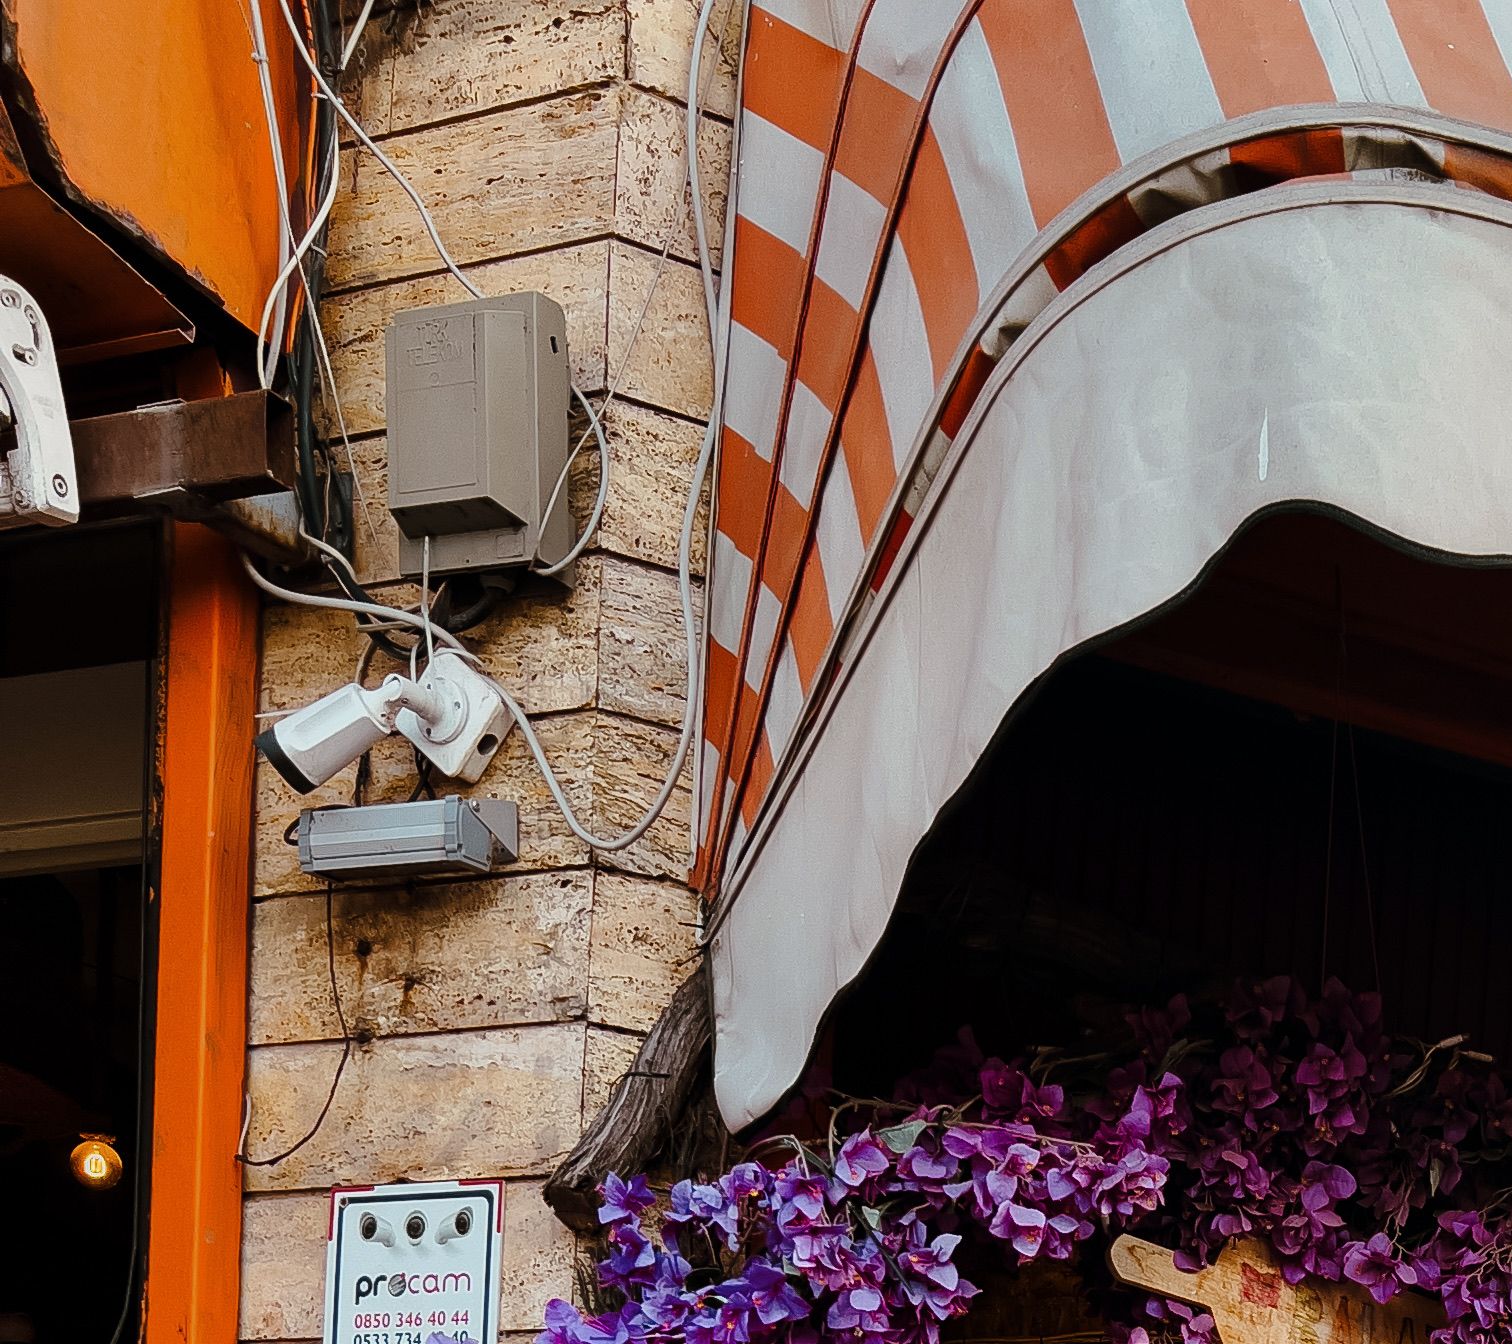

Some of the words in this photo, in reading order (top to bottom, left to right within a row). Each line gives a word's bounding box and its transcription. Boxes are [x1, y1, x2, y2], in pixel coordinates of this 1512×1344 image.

[354, 1272, 471, 1306] procam
[354, 1313, 391, 1329] 0850
[395, 1312, 423, 1328] 346
[427, 1310, 446, 1327] 40
[451, 1310, 470, 1326] 44
